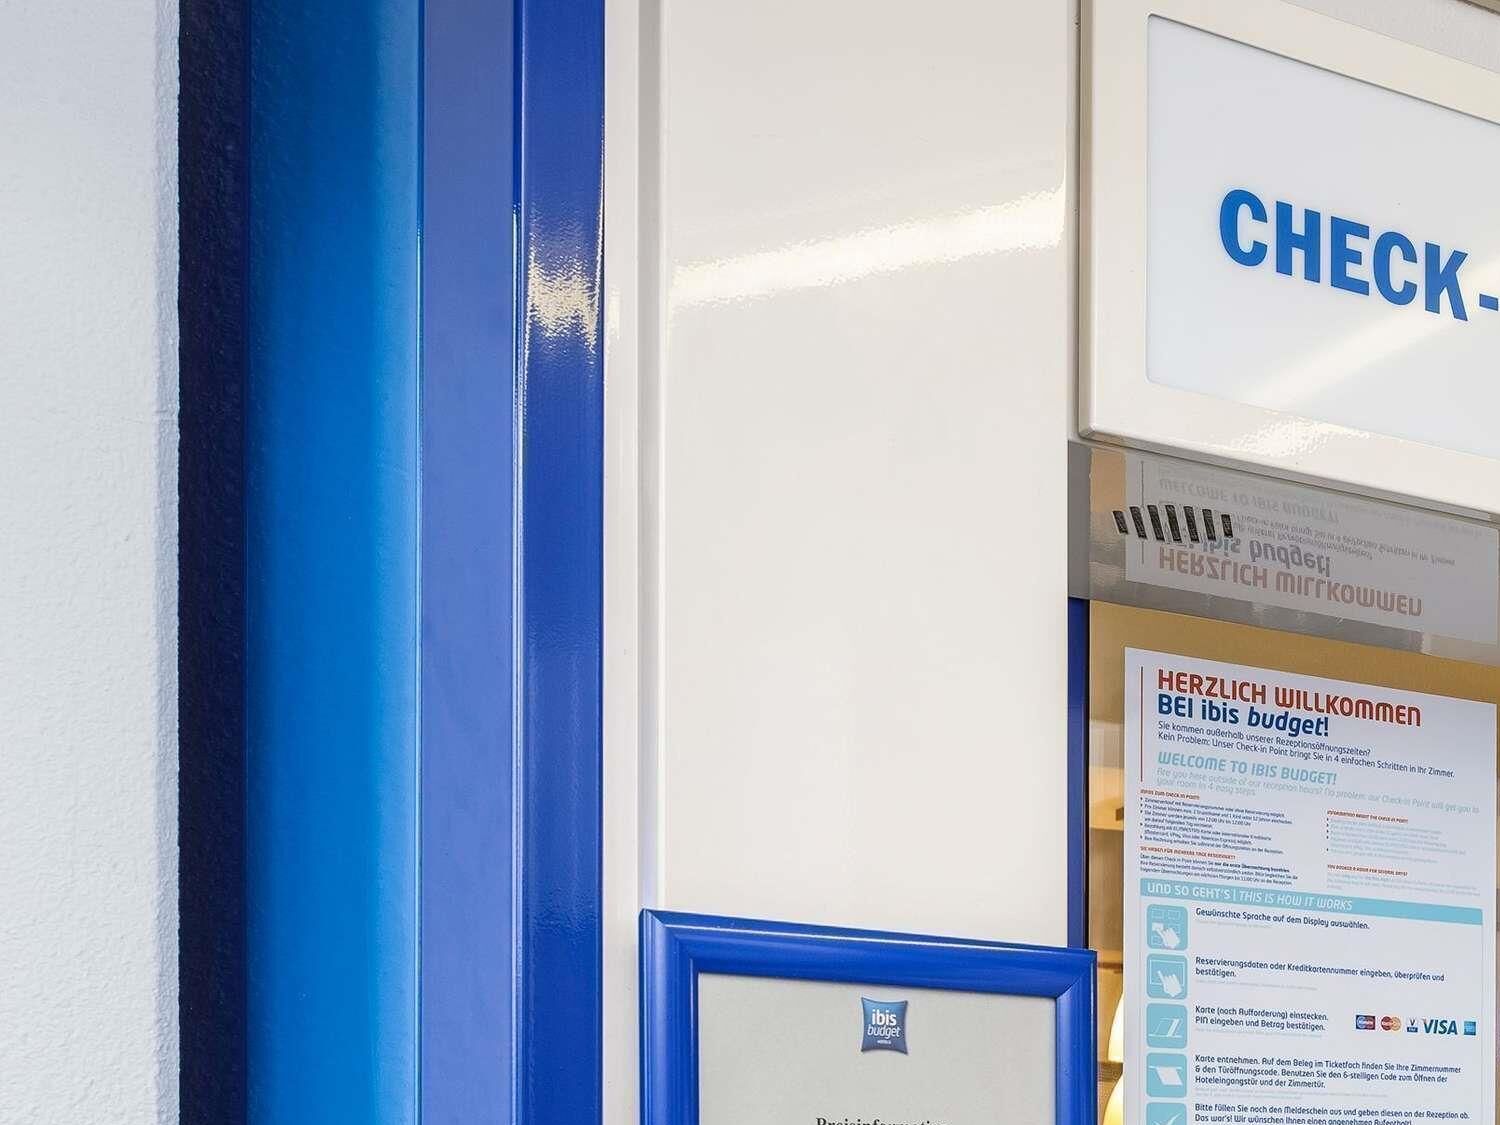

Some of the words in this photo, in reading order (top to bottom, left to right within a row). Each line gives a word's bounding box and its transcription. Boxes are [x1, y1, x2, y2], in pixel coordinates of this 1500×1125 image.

[1158, 669, 1266, 704] HERZLICH
[1274, 687, 1421, 725] WILLKOMMEN
[1158, 693, 1193, 718] BEI
[1201, 699, 1239, 724] ibis
[1248, 706, 1329, 737] budget!
[1157, 751, 1226, 771] WELCOME
[1230, 760, 1248, 774] TO
[1251, 762, 1277, 778] IBIS
[1280, 766, 1337, 785] BUDGET!
[872, 1009, 897, 1025] ibis
[1423, 1019, 1458, 1035] VISA
[867, 1024, 901, 1039] budget
